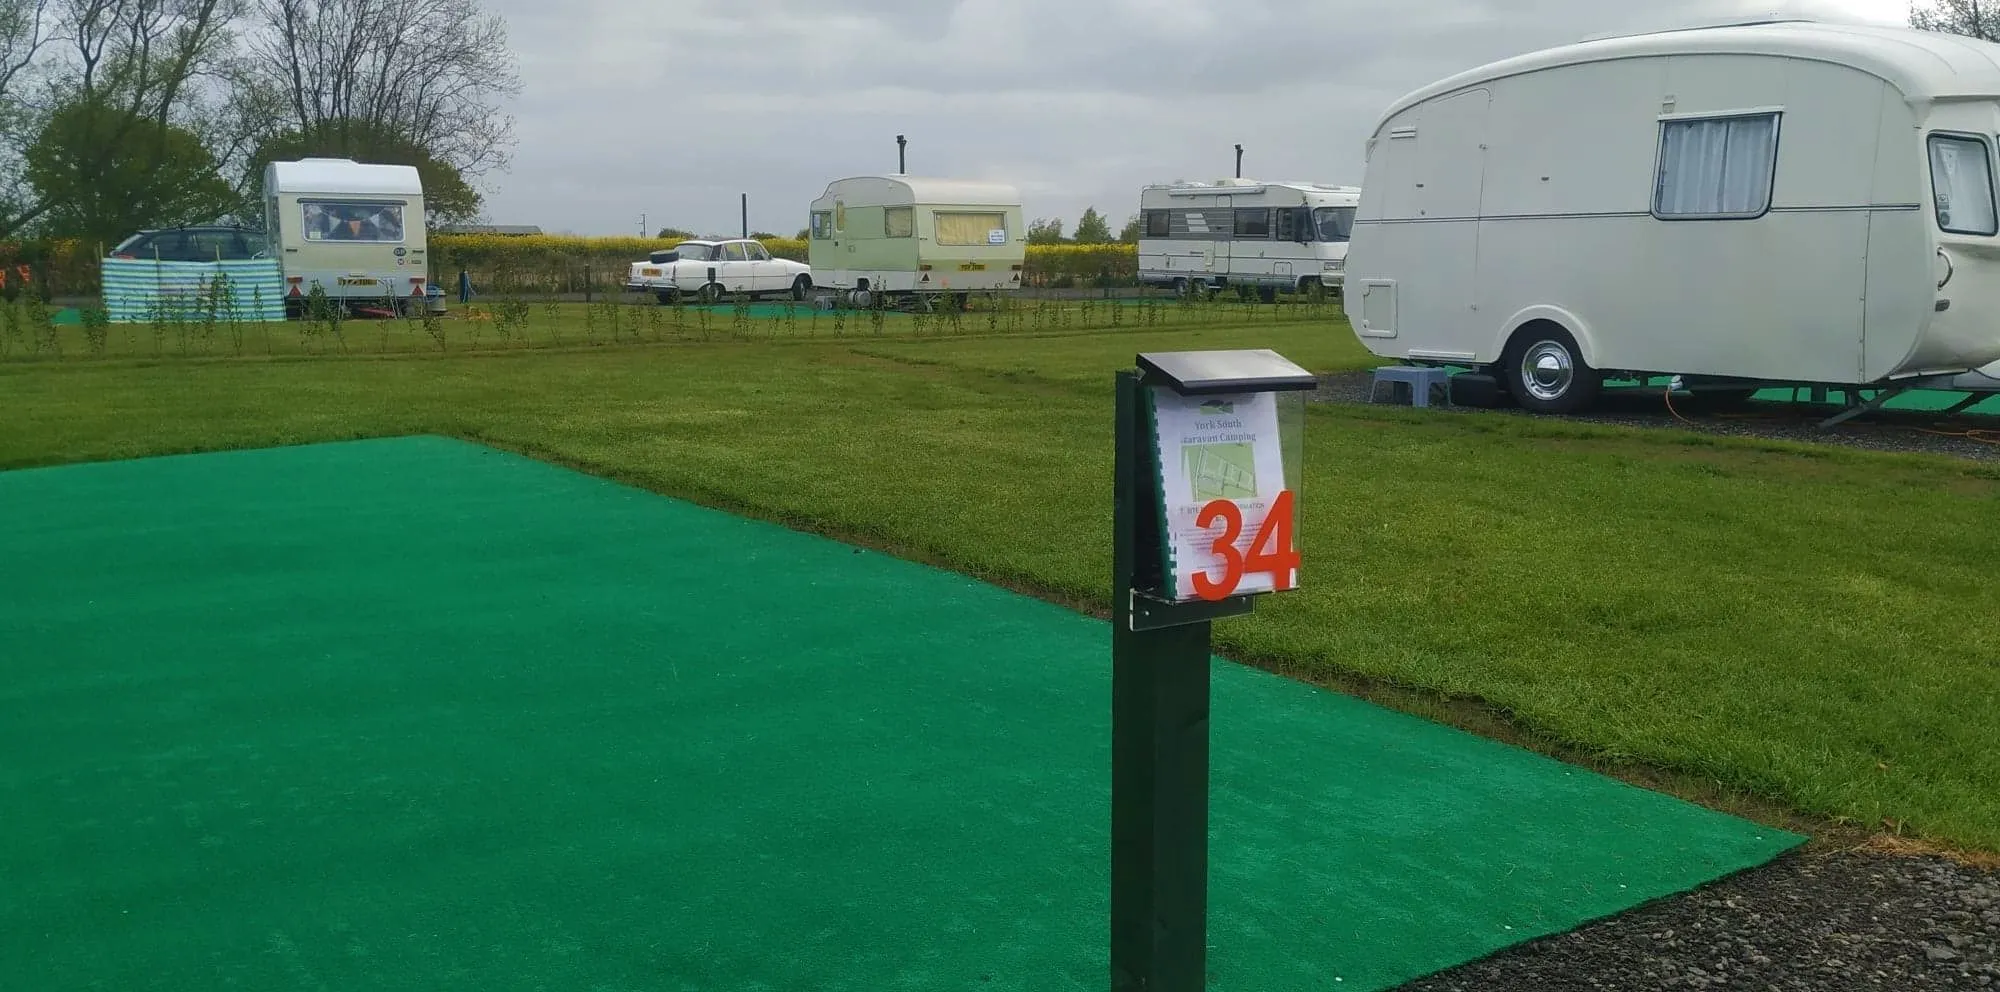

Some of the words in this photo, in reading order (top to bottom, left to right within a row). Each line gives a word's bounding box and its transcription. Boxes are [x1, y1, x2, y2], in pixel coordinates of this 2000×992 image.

[1194, 420, 1216, 430] York
[1216, 419, 1243, 429] South
[1219, 432, 1257, 443] Camping
[1191, 489, 1302, 601] 34
